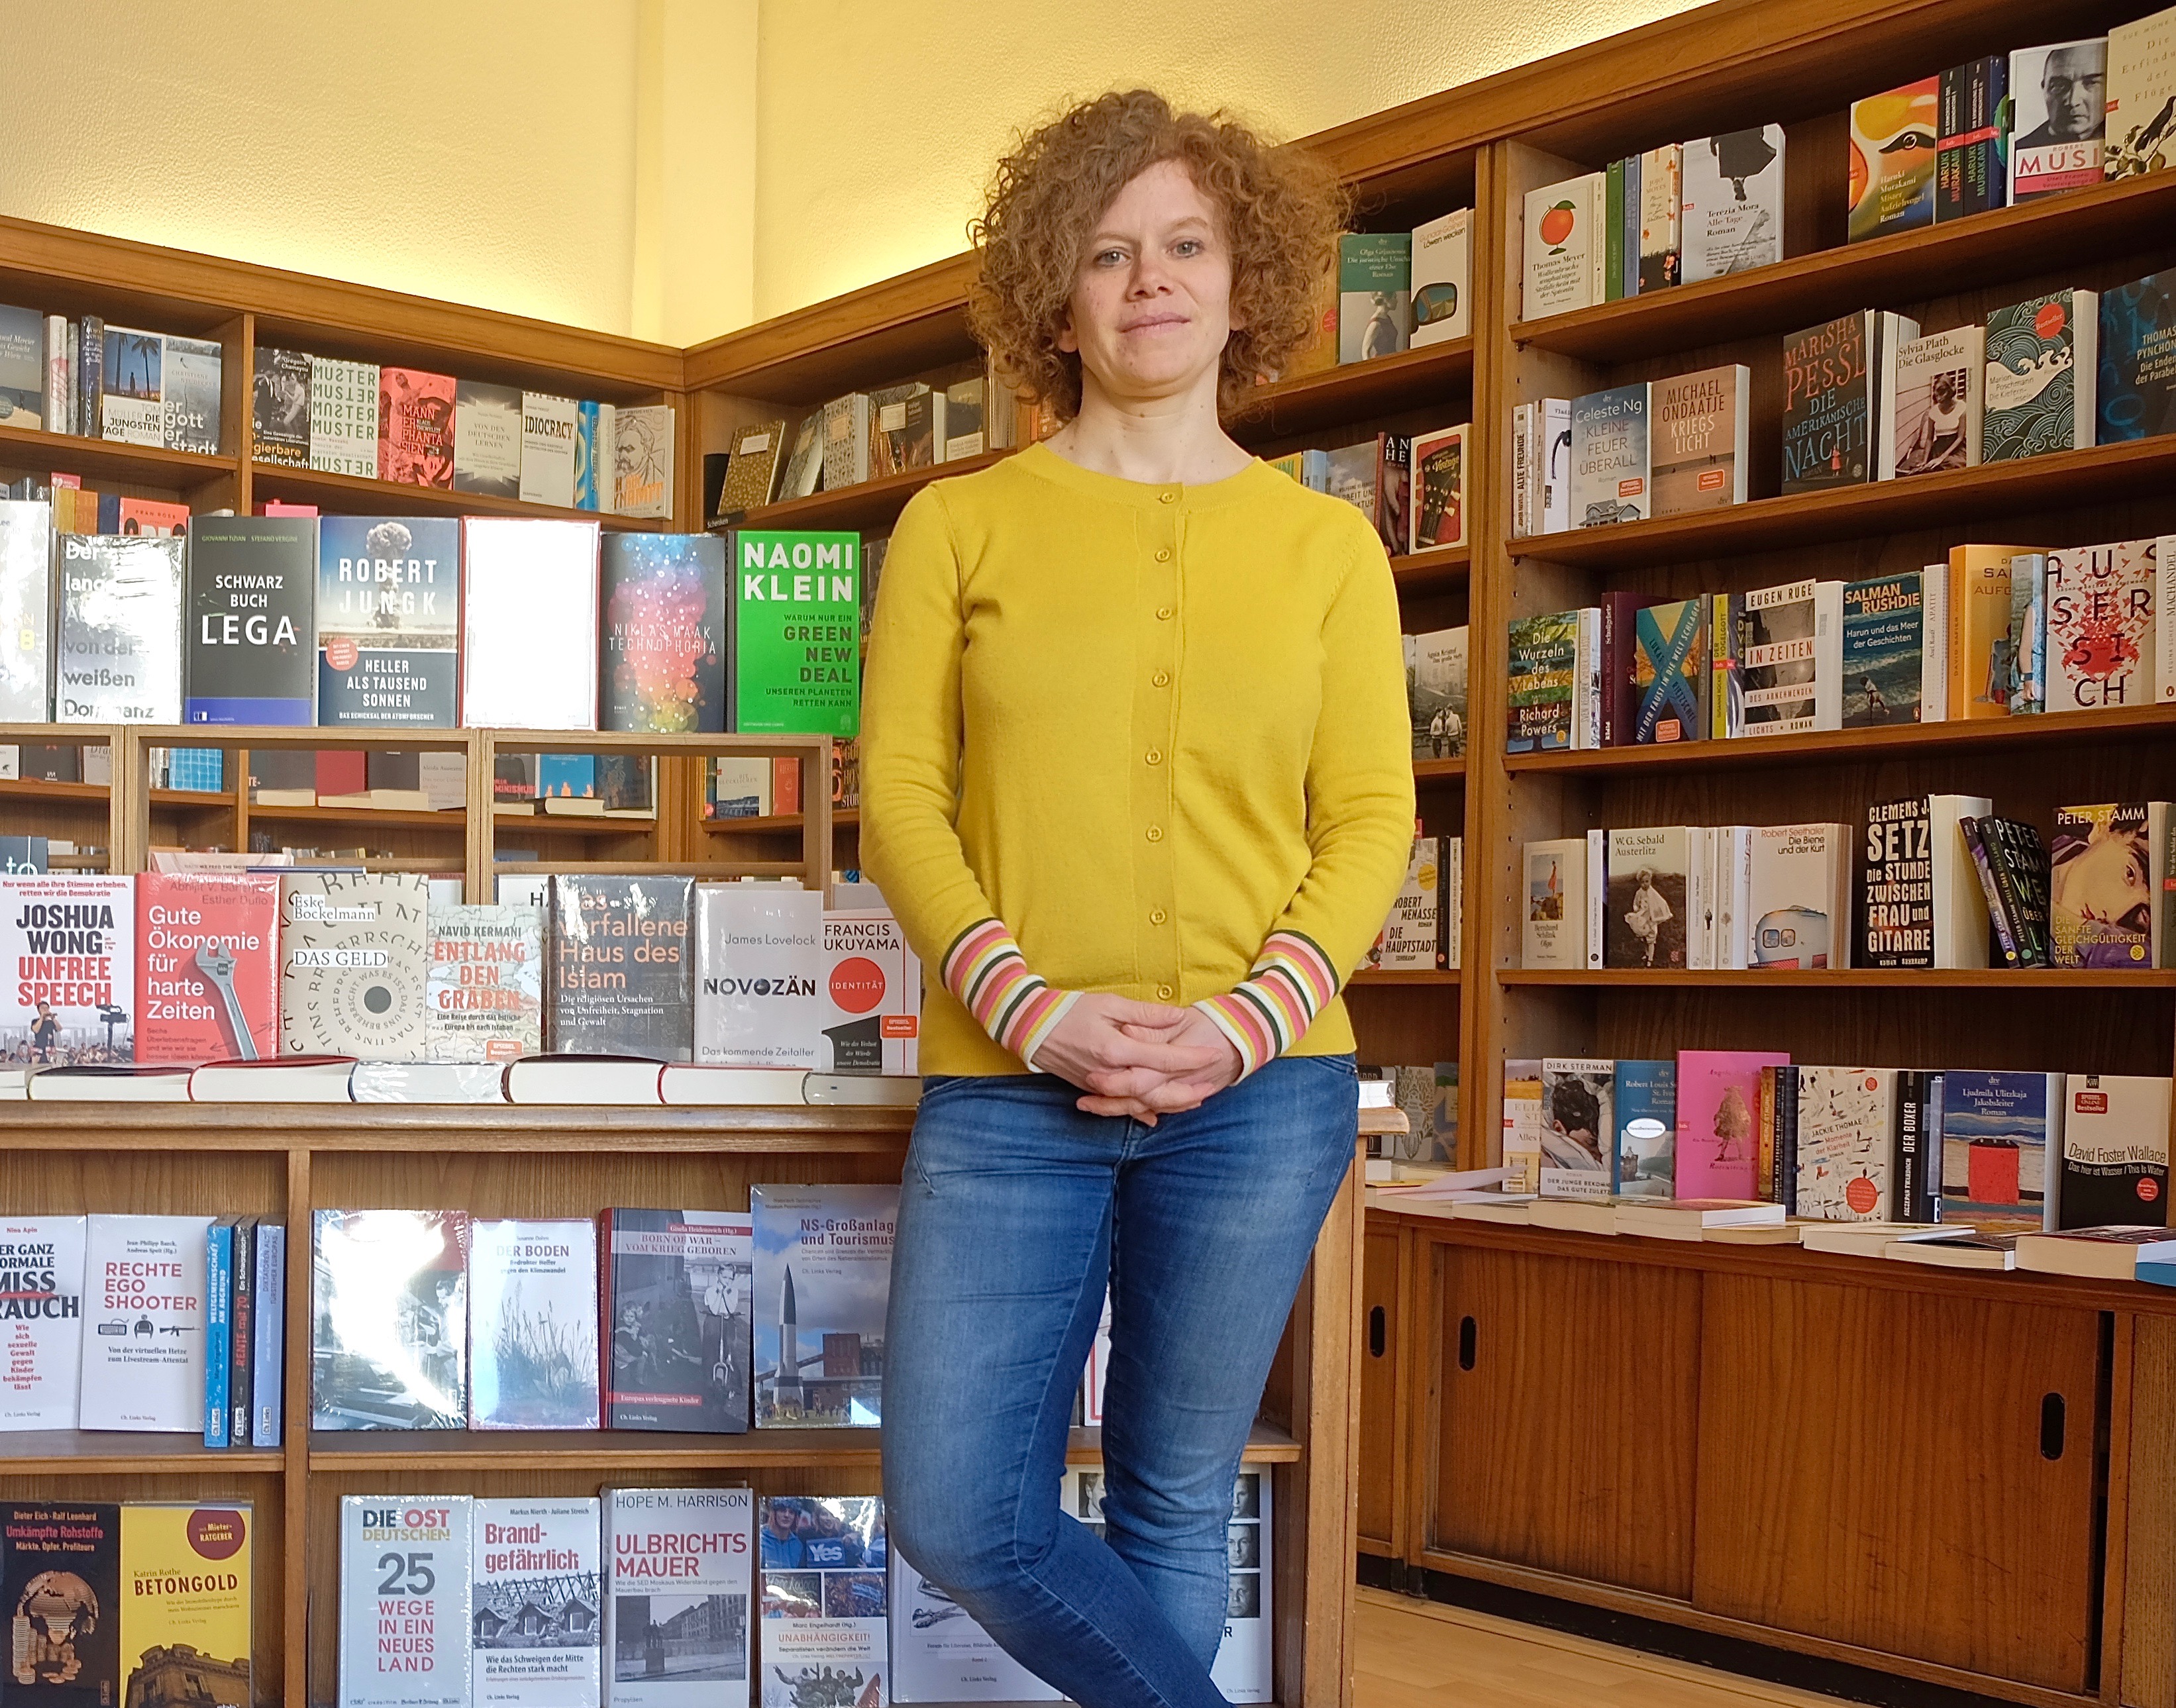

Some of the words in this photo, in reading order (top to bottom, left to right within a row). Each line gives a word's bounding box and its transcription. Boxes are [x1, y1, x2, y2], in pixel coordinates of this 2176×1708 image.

[1940, 152, 1949, 189] HARUKI
[1967, 145, 1977, 183] HARUKI
[1977, 144, 1986, 197] MURAKAMI
[1951, 150, 1961, 203] MURAKAMI
[1706, 207, 1736, 218] Terezia
[1737, 203, 1759, 212] Mora
[1706, 226, 1736, 237] Roman
[1784, 316, 1857, 368] MARISHA
[1898, 342, 1924, 358] Sylvia
[1926, 336, 1949, 351] Plath
[1898, 357, 1913, 369] Die
[1915, 344, 1964, 366] Glasglocke
[1785, 333, 1867, 412] PESSL
[1666, 379, 1721, 405] MICHAEL
[1575, 405, 1620, 423] Celeste
[1623, 399, 1642, 413] Ng
[1662, 395, 1725, 422] ONDAATJE
[1810, 387, 1836, 417] DIE
[145, 414, 160, 423] DIE
[165, 413, 203, 429] gott
[402, 406, 435, 419] MANN
[311, 419, 375, 440] MUSTER
[525, 415, 573, 440] IDIOCRACY
[1586, 419, 1630, 438] KLEINE
[1671, 415, 1715, 438] KRIEGS
[402, 430, 442, 444] PHANTA
[1675, 434, 1710, 454] LICHT
[1587, 437, 1628, 456] FEUER
[1785, 412, 1866, 481] NACHT
[1580, 454, 1637, 476] ÜBERALL
[707, 517, 729, 528] Schenken
[744, 542, 853, 569] NAOMI
[339, 558, 437, 583] ROBERT
[215, 576, 284, 589] SCHWARZ
[744, 575, 852, 602] KLEIN
[231, 595, 268, 607] BUCH
[1751, 588, 1783, 607] EUGEN
[1788, 583, 1812, 599] RUGE
[1845, 583, 1900, 604] SALMAN
[338, 591, 436, 615] JUNGK
[1862, 593, 1920, 614] RUSHDIE
[202, 615, 297, 644] LEGA
[615, 623, 666, 636] NIKLAS
[674, 627, 711, 640] MAAK
[784, 627, 852, 642] GREEN
[1533, 632, 1550, 643] Die
[1847, 627, 1869, 638] Harun
[1871, 626, 1885, 636] und
[1886, 624, 1899, 634] das
[1900, 621, 1918, 630] Meer
[609, 638, 716, 654] TECHNOPHORIA
[1867, 634, 1912, 647] Geschichten
[805, 648, 852, 662] NEW
[1520, 647, 1565, 661] Wurzeln
[1749, 650, 1763, 665] IN
[1769, 640, 1813, 660] ZEITEN
[365, 660, 409, 673] HELLER
[800, 668, 852, 683] DEAL
[66, 669, 135, 686] weißen
[347, 676, 369, 689] ALS
[373, 677, 427, 691] TAUSEND
[363, 693, 410, 707] SONNEN
[1520, 707, 1560, 722] Richard
[1521, 723, 1557, 736] Powers
[1869, 801, 1918, 823] CLEMENS
[2057, 813, 2092, 825] PETER
[2097, 807, 2144, 822] STAMM
[1637, 835, 1665, 845] Sebald
[1761, 829, 1787, 838] Robert
[1788, 827, 1825, 837] Seethaler
[1868, 820, 1928, 862] SETZ
[1615, 846, 1656, 856] Austerlitz
[1867, 869, 1882, 881] Die
[1885, 862, 1930, 881] STUNDE
[1867, 882, 1930, 903] ZWISCHEN
[295, 897, 324, 907] Eske
[17, 905, 114, 929] JOSHUA
[148, 906, 201, 924] Gute
[295, 908, 375, 920] Bockelmann
[1401, 907, 1436, 920] MENASSE
[1869, 904, 1910, 927] FRAU
[1912, 906, 1929, 921] und
[148, 927, 259, 950] Ökonomie
[439, 927, 470, 937] NAVID
[474, 927, 521, 938] KERMANI
[725, 934, 762, 945] James
[766, 934, 815, 945] Lovelock
[825, 925, 890, 936] FRANCIS
[2055, 933, 2146, 944] GLEICHGÜLTIGKEIT
[26, 931, 103, 955] WONG
[1386, 940, 1437, 953] HAUPTSTADT
[1868, 930, 1930, 952] GITARRE
[295, 952, 330, 966] DAS
[336, 952, 386, 966] GELD
[435, 942, 525, 961] ENTLANG
[560, 940, 625, 962] Haus
[634, 940, 680, 962] des
[2055, 954, 2079, 964] WELT
[19, 957, 111, 980] UNFREE
[148, 954, 178, 972] für
[460, 966, 499, 985] DEN
[560, 966, 626, 988] Islam
[831, 980, 883, 989] IDENTITÄT
[19, 983, 111, 1007] SPEECH
[148, 978, 204, 996] harte
[703, 976, 815, 996] NOVOZÄN
[439, 986, 520, 1010] GRÄBEN
[147, 1001, 215, 1020] Zeiten
[702, 1047, 721, 1056] Das
[723, 1048, 773, 1056] kommende
[776, 1048, 814, 1056] Zeitalter
[1903, 1103, 1916, 1131] BOXER
[1902, 1133, 1916, 1152] DER
[2069, 1143, 2095, 1160] David
[2098, 1147, 2125, 1162] Foster
[2128, 1147, 2166, 1163] Wallace
[801, 1234, 824, 1245] und
[829, 1234, 895, 1246] Tourismus
[525, 1246, 569, 1257] BODEN
[688, 1246, 737, 1255] GEBOREN
[106, 1262, 182, 1277] RECHTE
[105, 1280, 145, 1293] EGO
[105, 1295, 197, 1310] SHOOTER
[616, 1496, 653, 1508] HOPE
[658, 1496, 672, 1508] M.
[677, 1495, 748, 1507] HARRISON
[362, 1509, 397, 1528] DIE
[404, 1509, 450, 1528] OST
[362, 1529, 450, 1541] DEUTSCHEN
[486, 1523, 547, 1544] Brand-
[616, 1534, 747, 1554] ULBRICHTS
[809, 1544, 842, 1562] Yes
[486, 1549, 579, 1574] gefährlich
[616, 1557, 699, 1578] MAUER
[160, 1568, 181, 1576] Rothe
[378, 1553, 435, 1595] 25
[134, 1574, 238, 1595] BETONGOLD
[378, 1601, 435, 1615] WEGE
[378, 1620, 395, 1634] IN
[404, 1620, 433, 1634] EIN
[378, 1638, 434, 1652] NEUES
[378, 1657, 434, 1672] LAND
